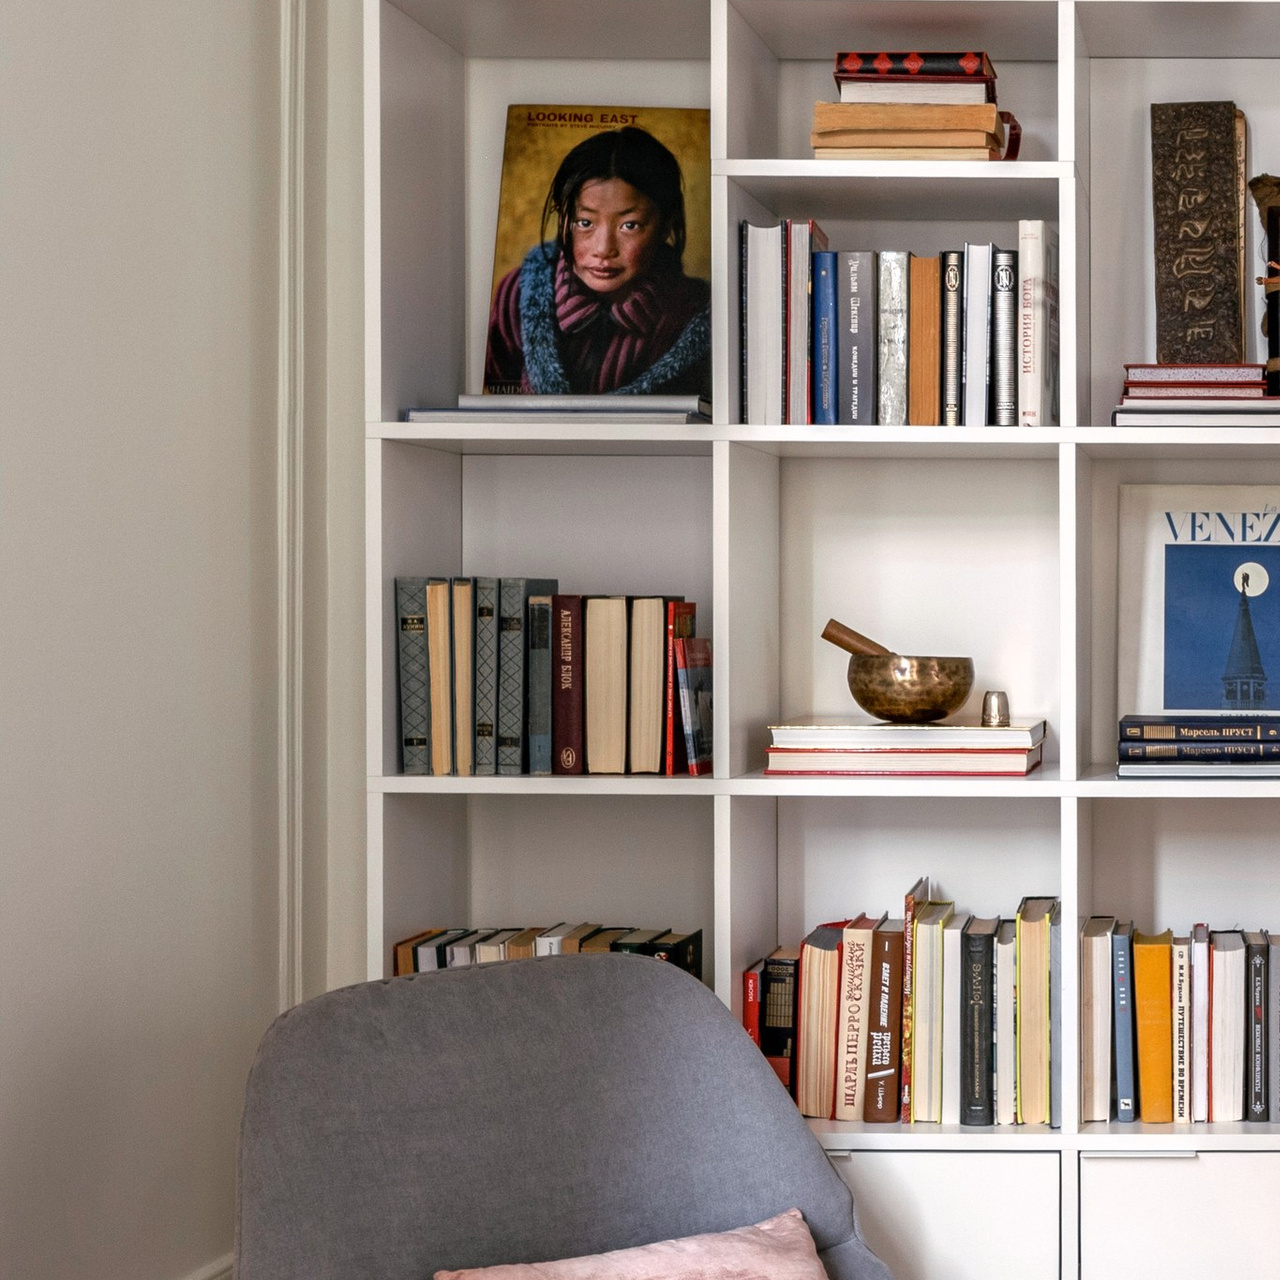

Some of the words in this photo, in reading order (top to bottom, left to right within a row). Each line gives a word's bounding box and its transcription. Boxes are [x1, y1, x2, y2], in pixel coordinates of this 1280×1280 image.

[527, 112, 594, 123] LOOKING
[600, 113, 638, 125] EAST
[1022, 278, 1032, 309] БОГА
[849, 297, 860, 334] Шекспир
[1022, 313, 1032, 374] ИСТОРИЯ
[850, 346, 858, 378] КОМЕДИИ
[850, 386, 858, 420] ТРАГЕДИИ
[1263, 504, 1279, 513] La
[560, 609, 571, 661] АЛЕКСАНДР
[560, 664, 571, 689] БЛОК
[1180, 728, 1220, 738] Марсель
[1222, 728, 1254, 737] ПРУСТ
[1182, 746, 1221, 756] Марсель
[1224, 745, 1257, 755] ПРУСТ
[904, 911, 913, 955] поверхности
[845, 941, 856, 1002] волшебные
[853, 942, 865, 1001] СКАЗКИ
[881, 962, 889, 986] ВЗЛЕТ
[903, 955, 912, 995] Имитируем
[879, 994, 888, 1027] ПАДЕНИЕ
[846, 1004, 861, 1055] ПЕРРО
[870, 1031, 883, 1065] рейха
[882, 1031, 892, 1064] третьего
[844, 1057, 858, 1107] ШАРЛЬ
[1178, 1067, 1185, 1077] ВО
[877, 1086, 885, 1110] Ширер
[1177, 1078, 1185, 1117] ВРЕМЕНИ
